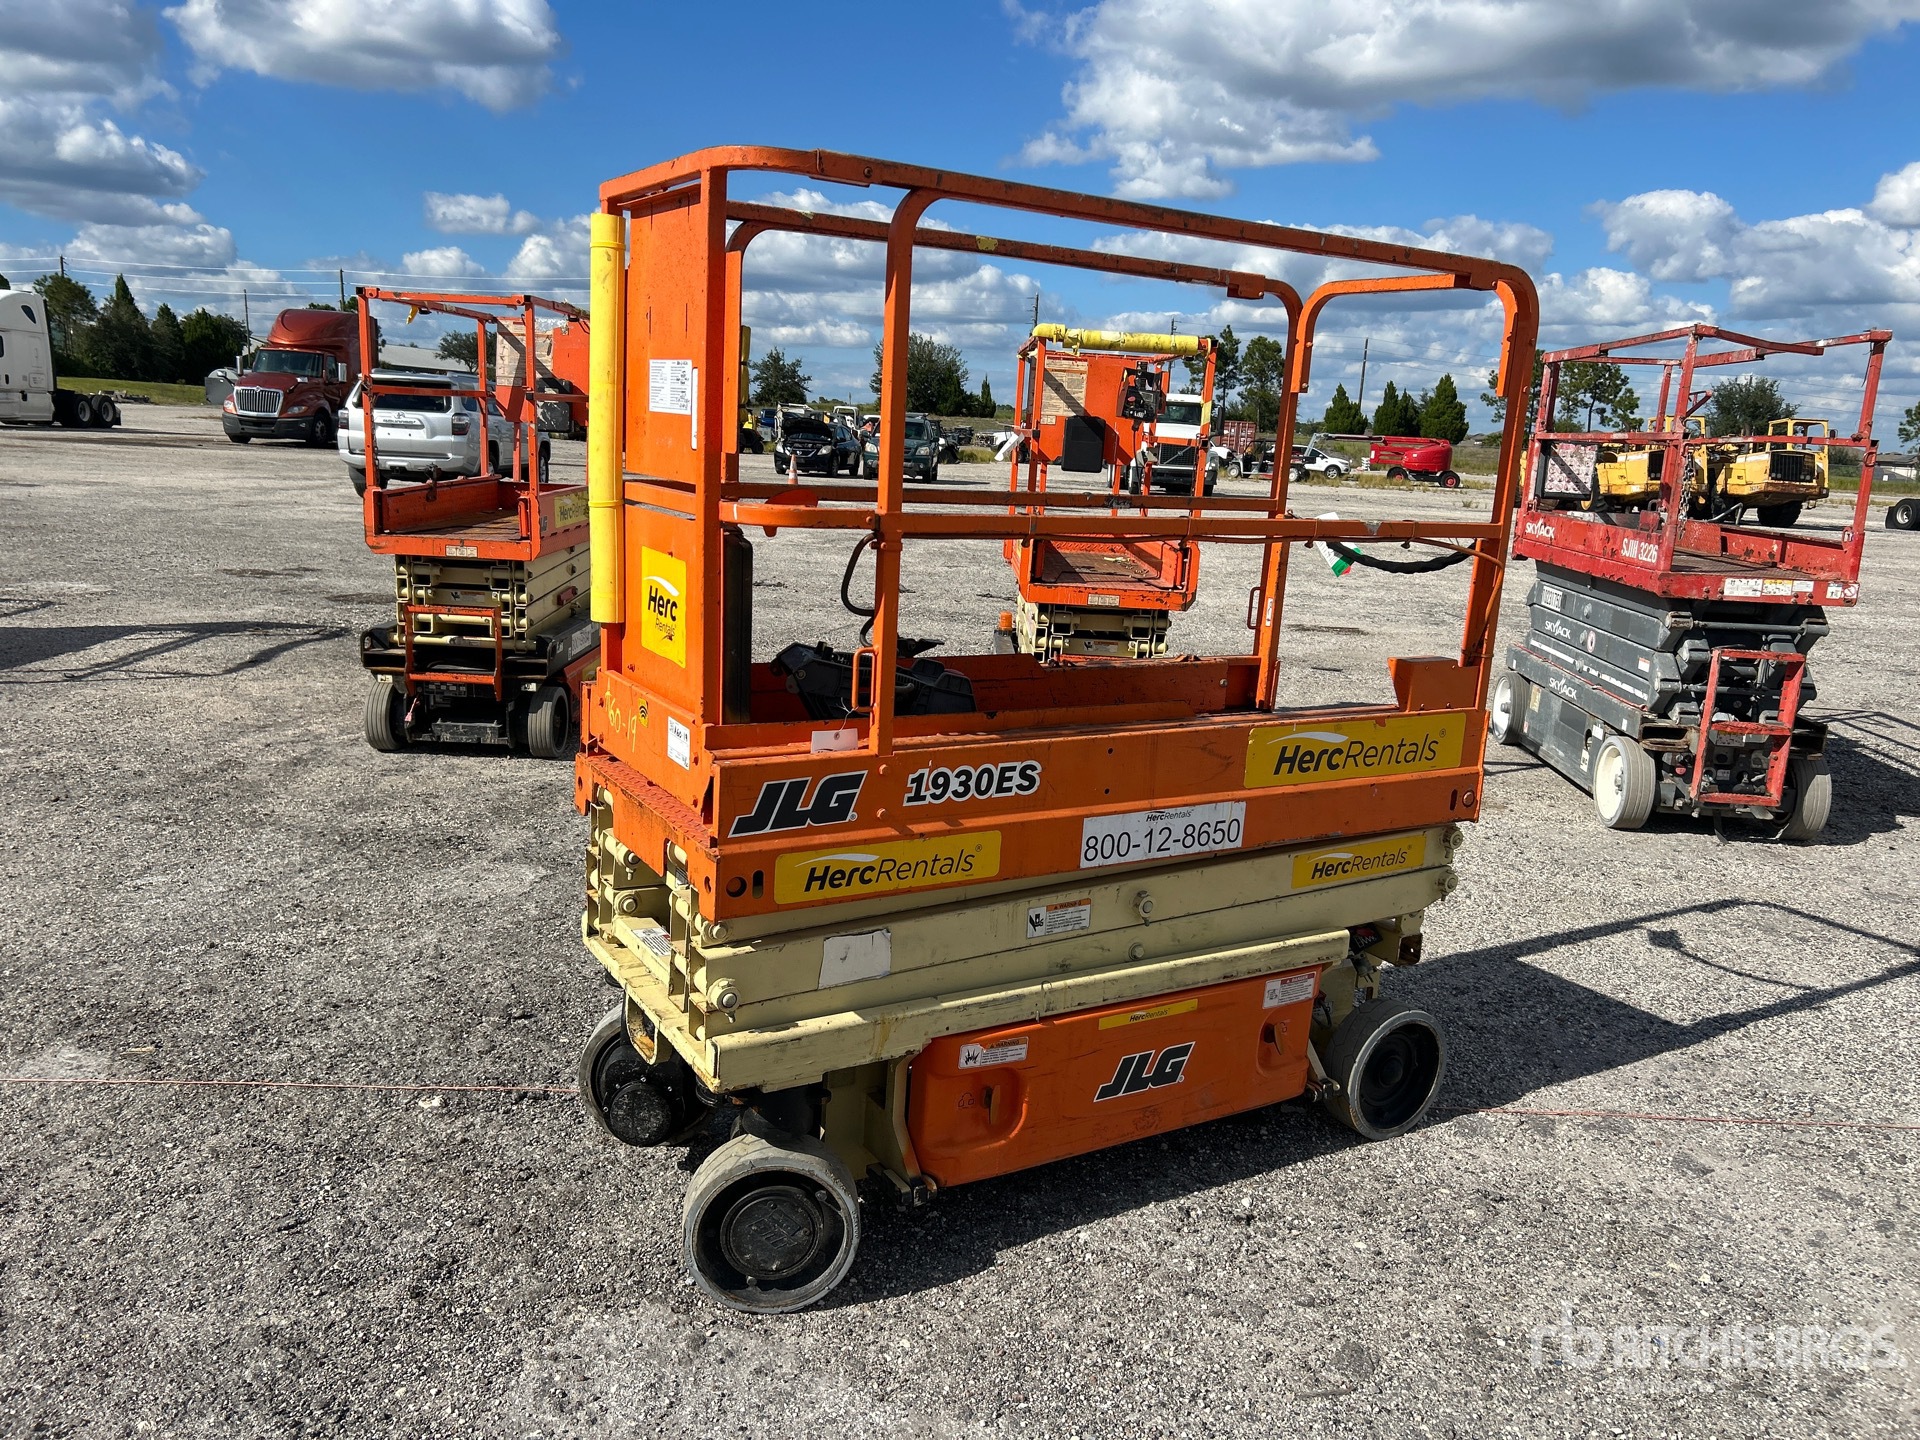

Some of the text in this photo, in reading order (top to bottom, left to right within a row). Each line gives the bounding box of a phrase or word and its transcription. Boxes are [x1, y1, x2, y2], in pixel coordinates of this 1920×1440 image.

[1526, 517, 1555, 539] SKYJACK
[1638, 541, 1659, 563] 3226
[647, 585, 678, 622] Herc
[655, 612, 677, 637] Rentals
[1545, 619, 1571, 640] SKYJACK
[1549, 677, 1577, 700] SKYJACK
[905, 761, 1041, 806] 1930ES
[729, 771, 868, 837] JLG
[1083, 818, 1241, 863] 800-12-8650
[1094, 1041, 1196, 1102] JLG
